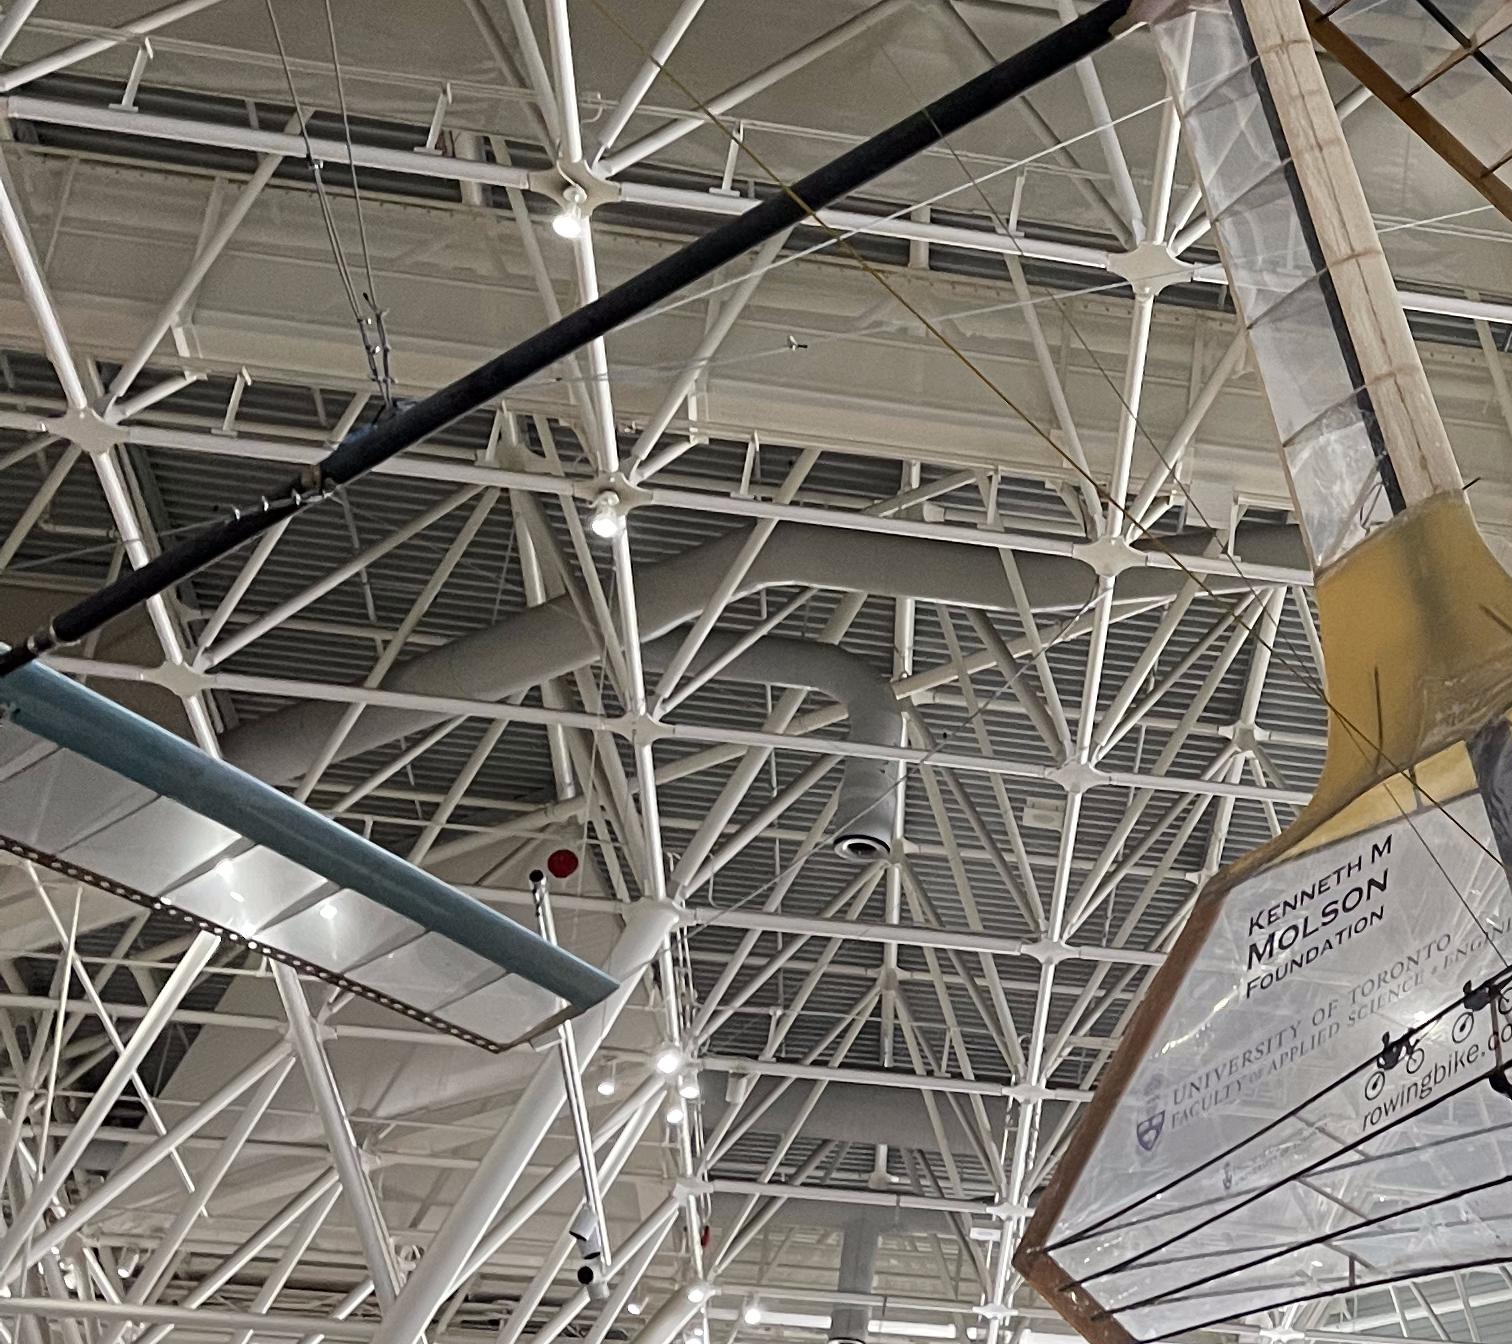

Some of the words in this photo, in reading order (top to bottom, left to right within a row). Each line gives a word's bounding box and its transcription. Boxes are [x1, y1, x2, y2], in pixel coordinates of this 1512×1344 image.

[1247, 868, 1388, 971] MOLSON
[1249, 855, 1362, 937] KENNETH
[1371, 834, 1393, 864] M
[1246, 905, 1384, 999] FOUNDATION
[1172, 1075, 1246, 1129] FACULTY
[1267, 1022, 1340, 1076] APPLIED
[1347, 965, 1425, 1027] SCIENCE
[1174, 1019, 1302, 1105] UNIVERSITY
[1312, 998, 1339, 1026] OF
[1349, 933, 1451, 1004] TORONTO
